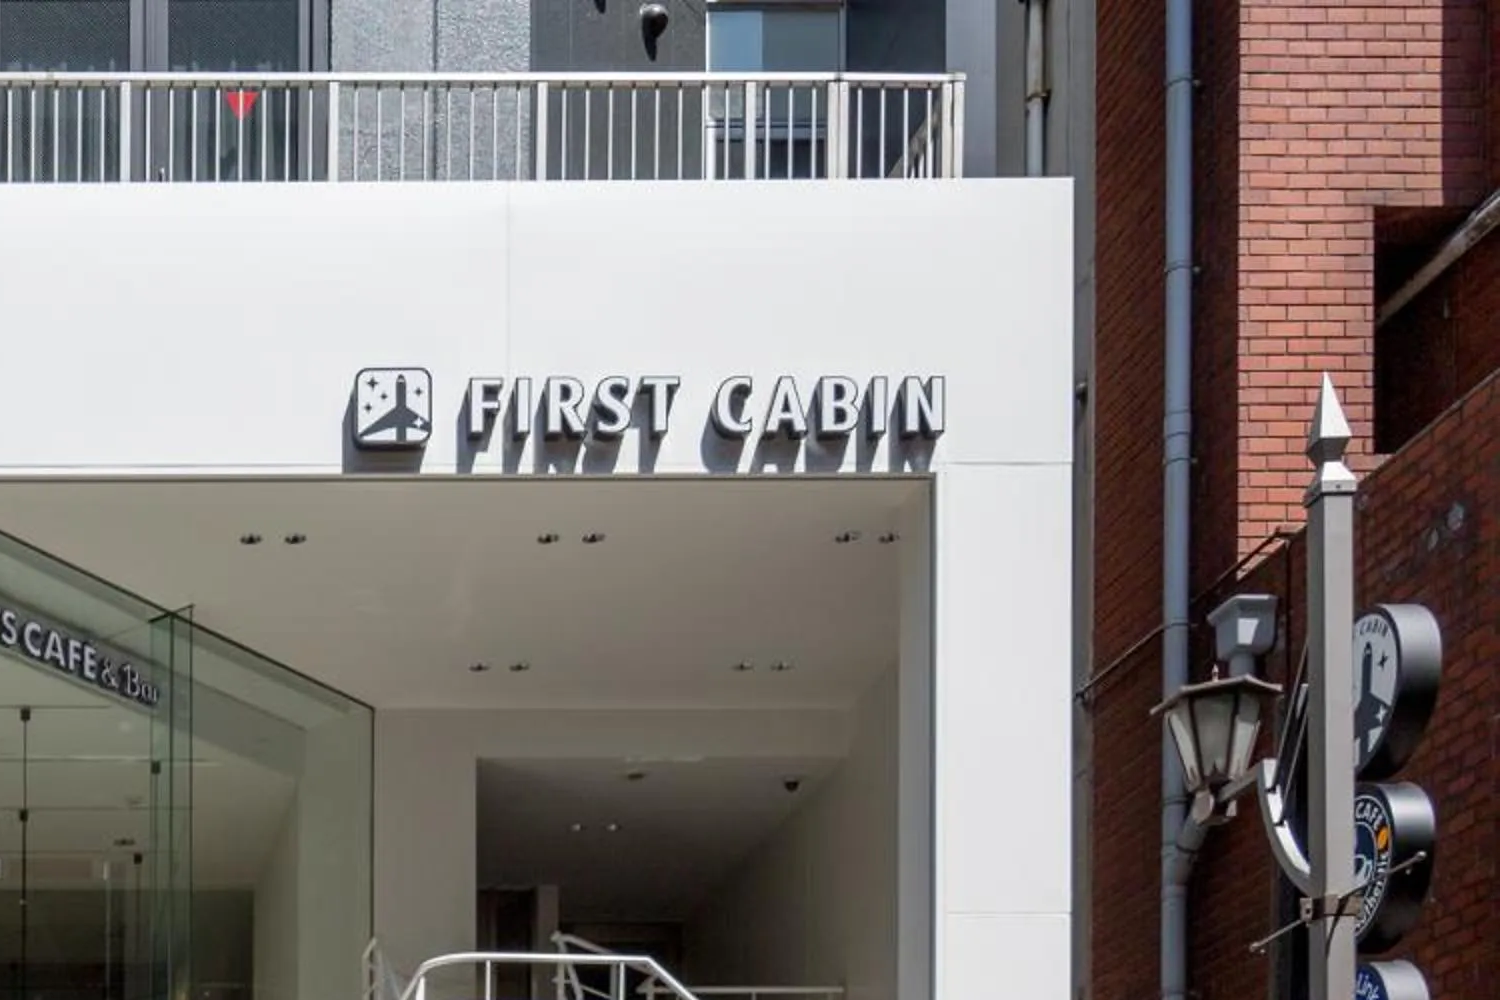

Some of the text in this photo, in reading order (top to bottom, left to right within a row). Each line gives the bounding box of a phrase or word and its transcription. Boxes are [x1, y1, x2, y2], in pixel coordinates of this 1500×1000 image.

[468, 374, 947, 437] FIRST CABIN
[23, 621, 98, 681] CAFE
